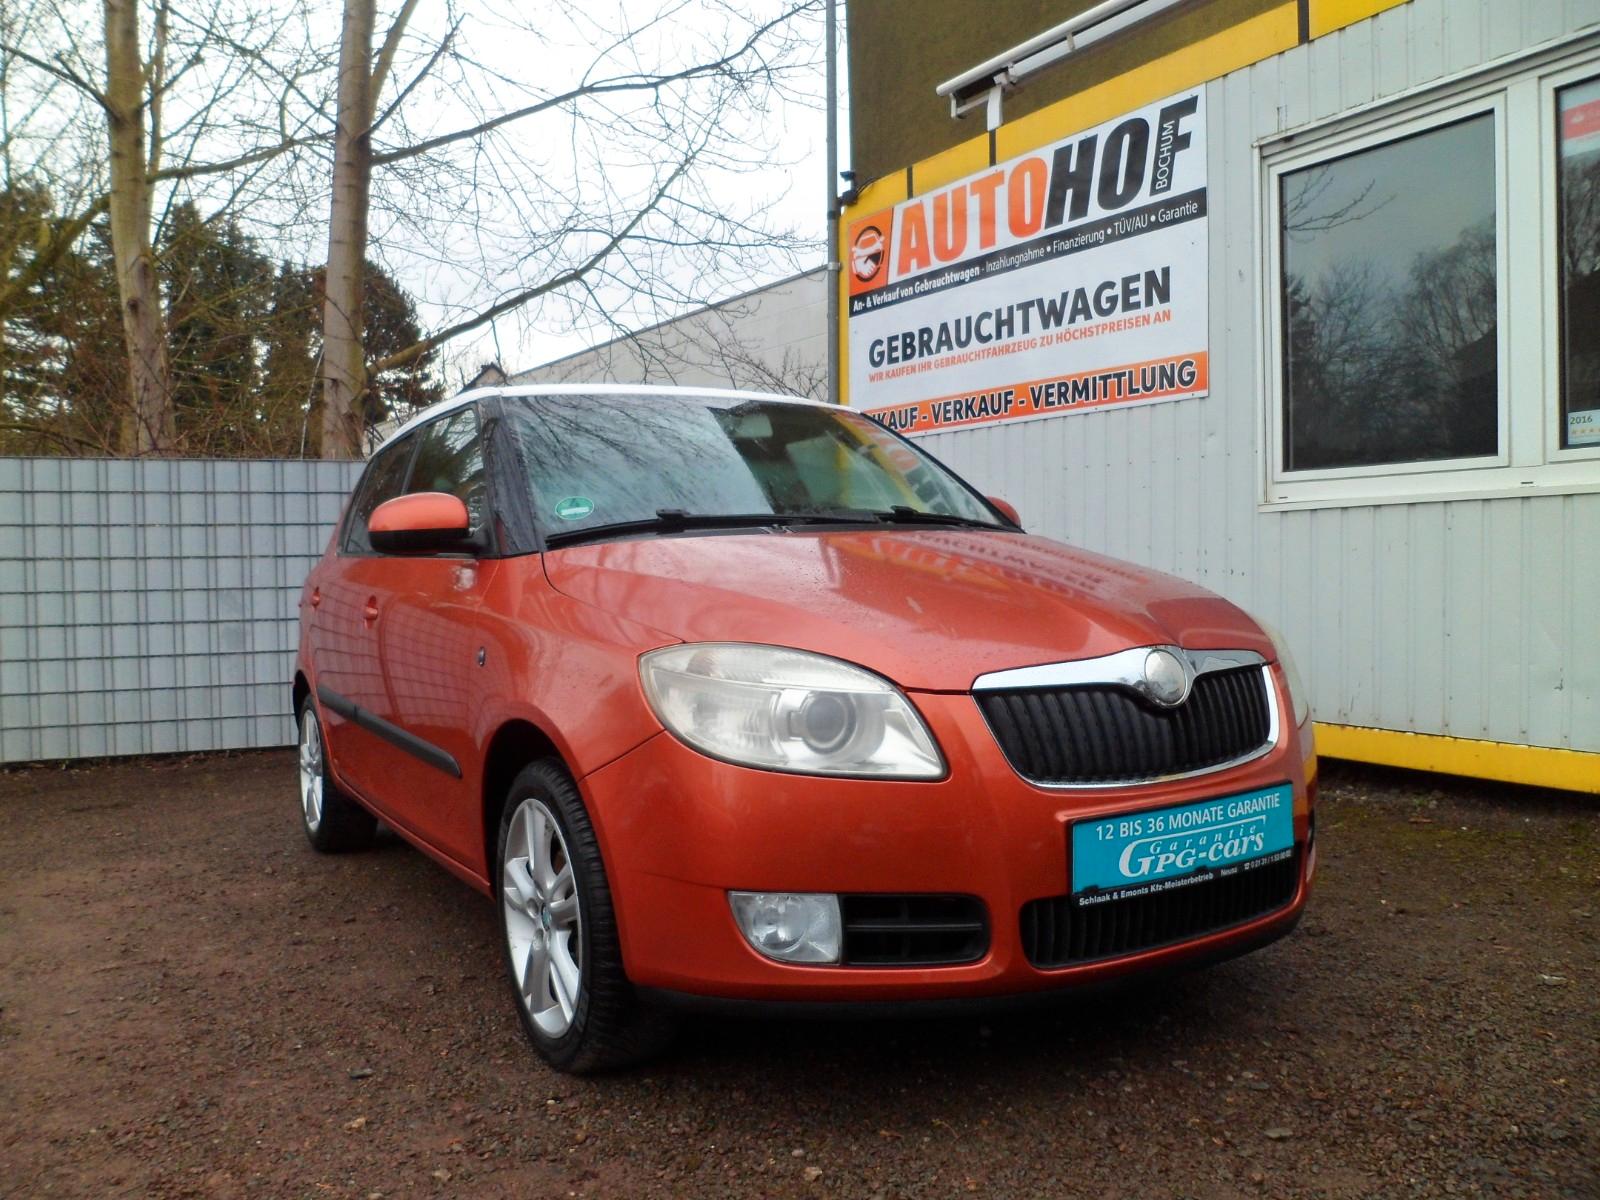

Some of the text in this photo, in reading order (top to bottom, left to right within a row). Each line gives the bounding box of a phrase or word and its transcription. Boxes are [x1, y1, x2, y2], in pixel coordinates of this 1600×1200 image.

[897, 95, 1199, 277] AUTOHOF
[1155, 120, 1176, 191] BOCHUM
[853, 300, 865, 312] An-
[866, 298, 872, 308] &
[873, 288, 900, 305] Verkauf
[900, 286, 914, 298] von
[914, 266, 980, 294] Gebrauchtwagen
[986, 247, 1045, 273] Inzahlungnahme
[1053, 229, 1105, 254] Finanzierung
[1113, 213, 1148, 236] TÜV/AU
[1158, 200, 1198, 223] Garantie
[868, 266, 1171, 368] GEBRAUCHTWAGEN
[868, 309, 1172, 383] WIR KAUFEN IHR GEBRAUCHTFAHRZEUG ZU HÖCHSTPREISEN AN
[931, 390, 1014, 424] VERKAUF
[1029, 360, 1196, 409] VERMITTLUNG
[1570, 415, 1593, 425] 2016
[1096, 793, 1280, 840] 12 BIS 36 MONATE GARANTIE
[1150, 825, 1257, 855] Garantie
[1112, 892, 1119, 900] &
[1120, 887, 1149, 899] Emonts
[1150, 872, 1214, 893] Kfz-Meisterbetrieb
